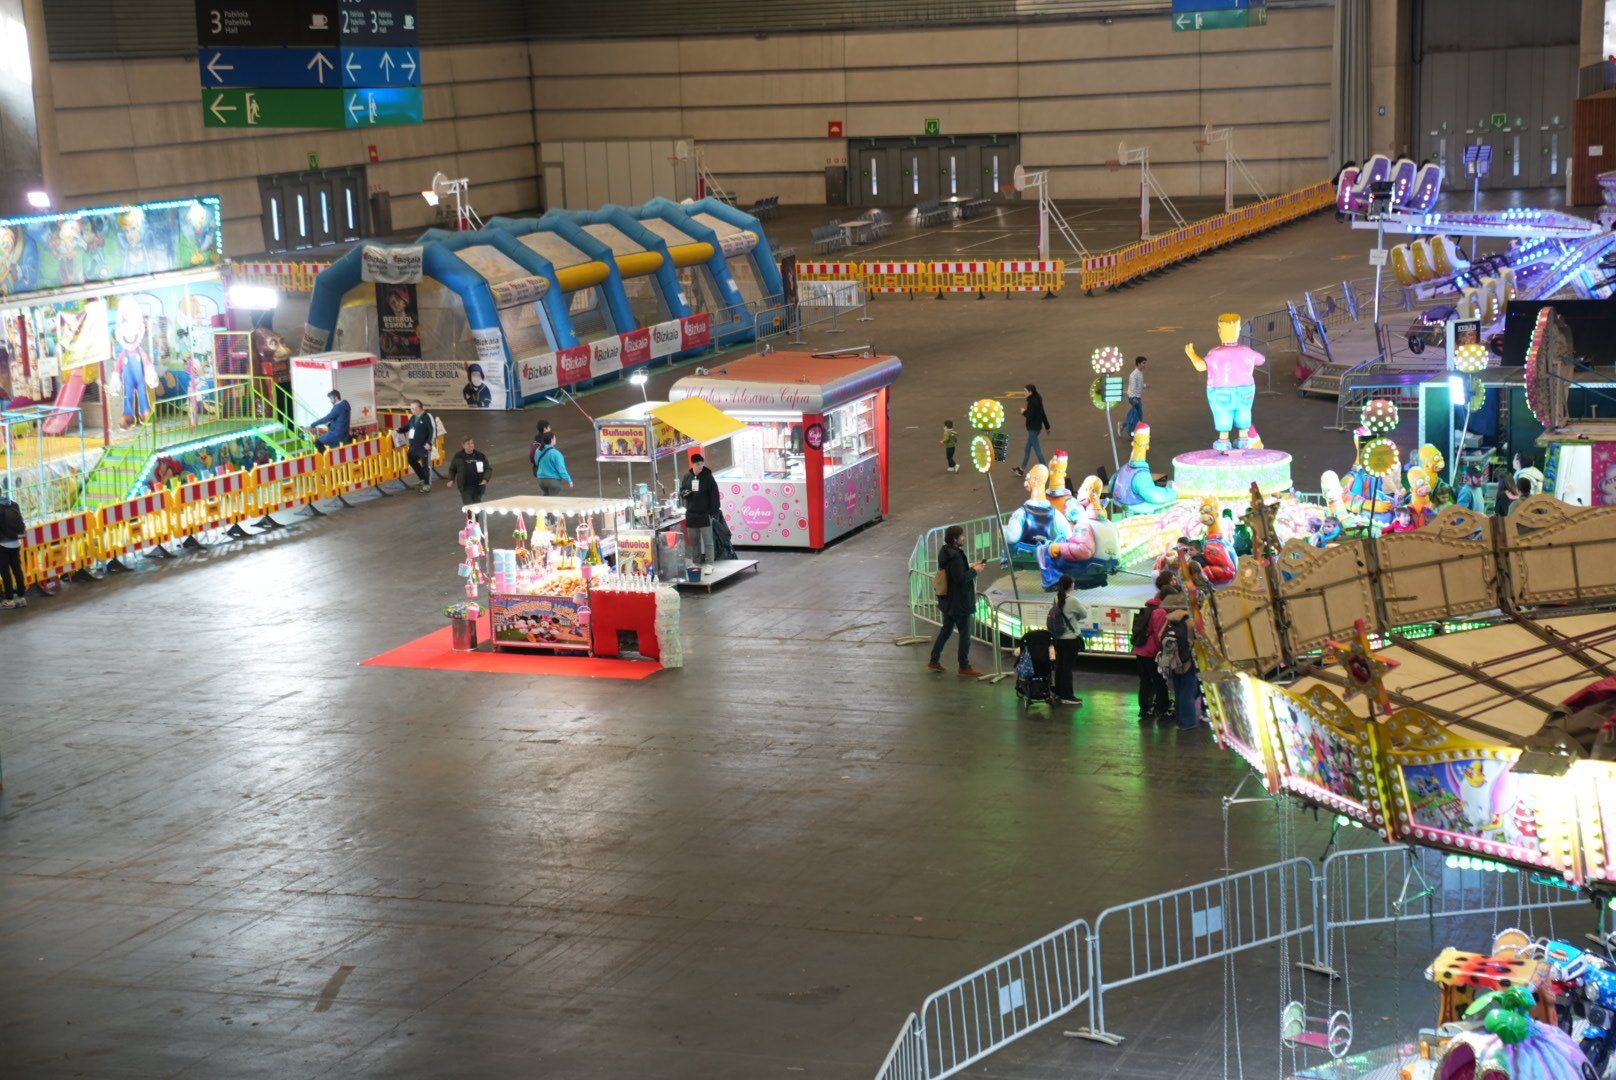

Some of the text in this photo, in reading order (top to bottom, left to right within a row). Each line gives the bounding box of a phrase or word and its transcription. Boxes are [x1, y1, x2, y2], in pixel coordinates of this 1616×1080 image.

[210, 10, 222, 34] 3
[342, 10, 350, 34] 2
[370, 10, 378, 34] 3
[687, 320, 707, 336] Bizkaia
[655, 329, 680, 344] Bizkaia
[627, 337, 648, 353] Bizkaia
[598, 346, 619, 362] Bizkaia
[401, 363, 429, 371] ESCUELA
[430, 363, 439, 371] DE
[565, 355, 588, 370] Bizkaia
[408, 370, 459, 379] BEISBOL ESKOLA
[527, 365, 553, 381] Bizkaia
[602, 428, 644, 437] Buñuelos
[741, 506, 771, 519] Capra
